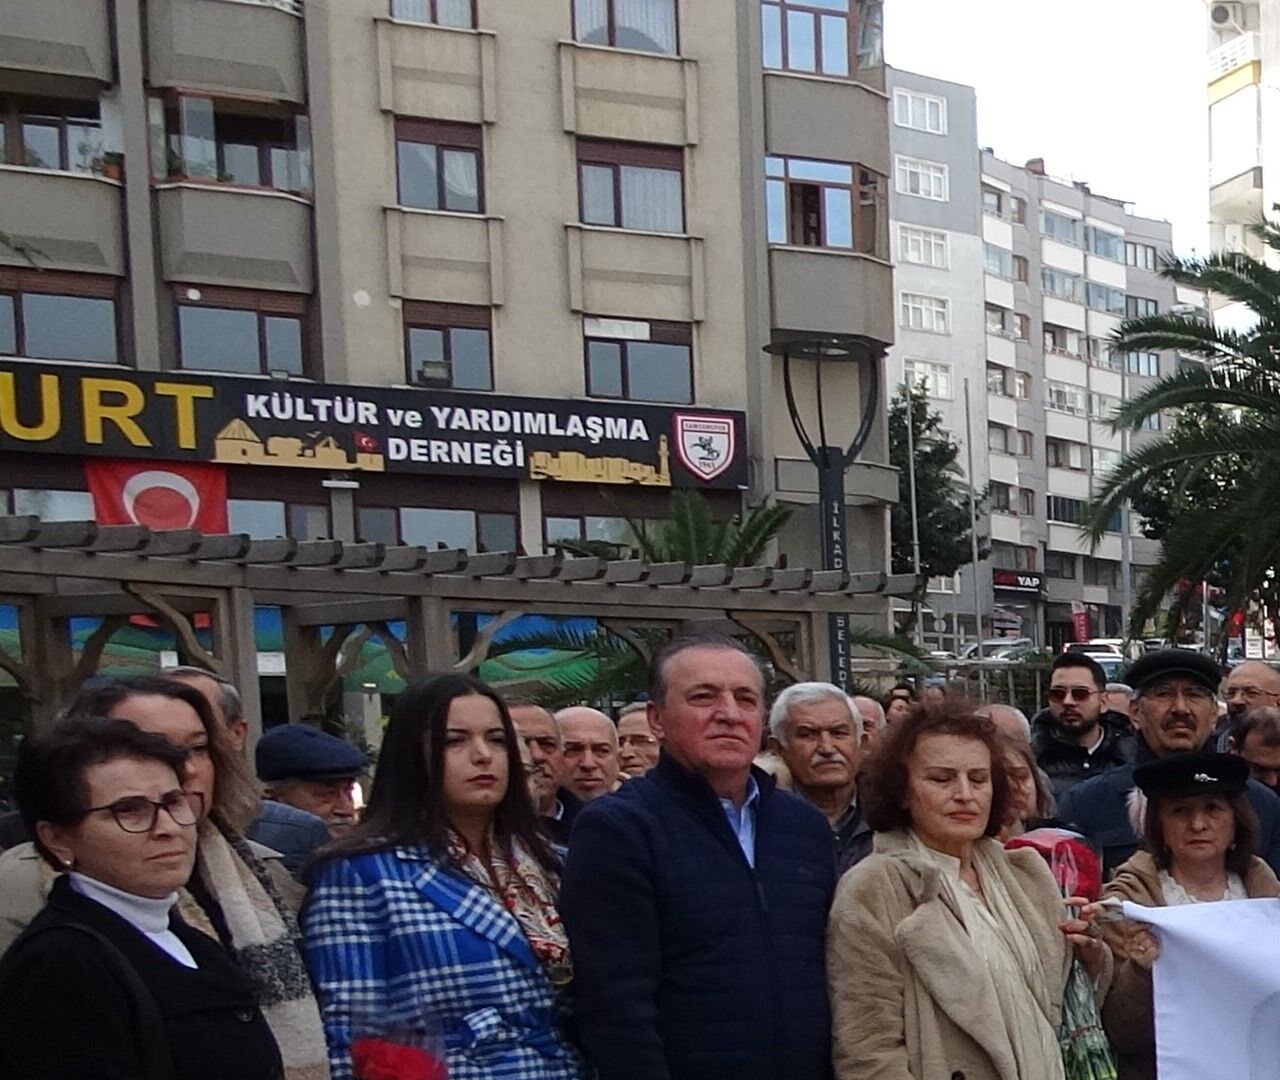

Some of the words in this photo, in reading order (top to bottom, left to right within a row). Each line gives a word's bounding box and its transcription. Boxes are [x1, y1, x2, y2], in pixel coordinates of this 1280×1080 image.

[246, 392, 379, 425] KÜLTÜR
[387, 407, 421, 428] ve
[430, 406, 649, 444] YARDIMLAŞMA
[388, 436, 525, 467] DERNEĞİ
